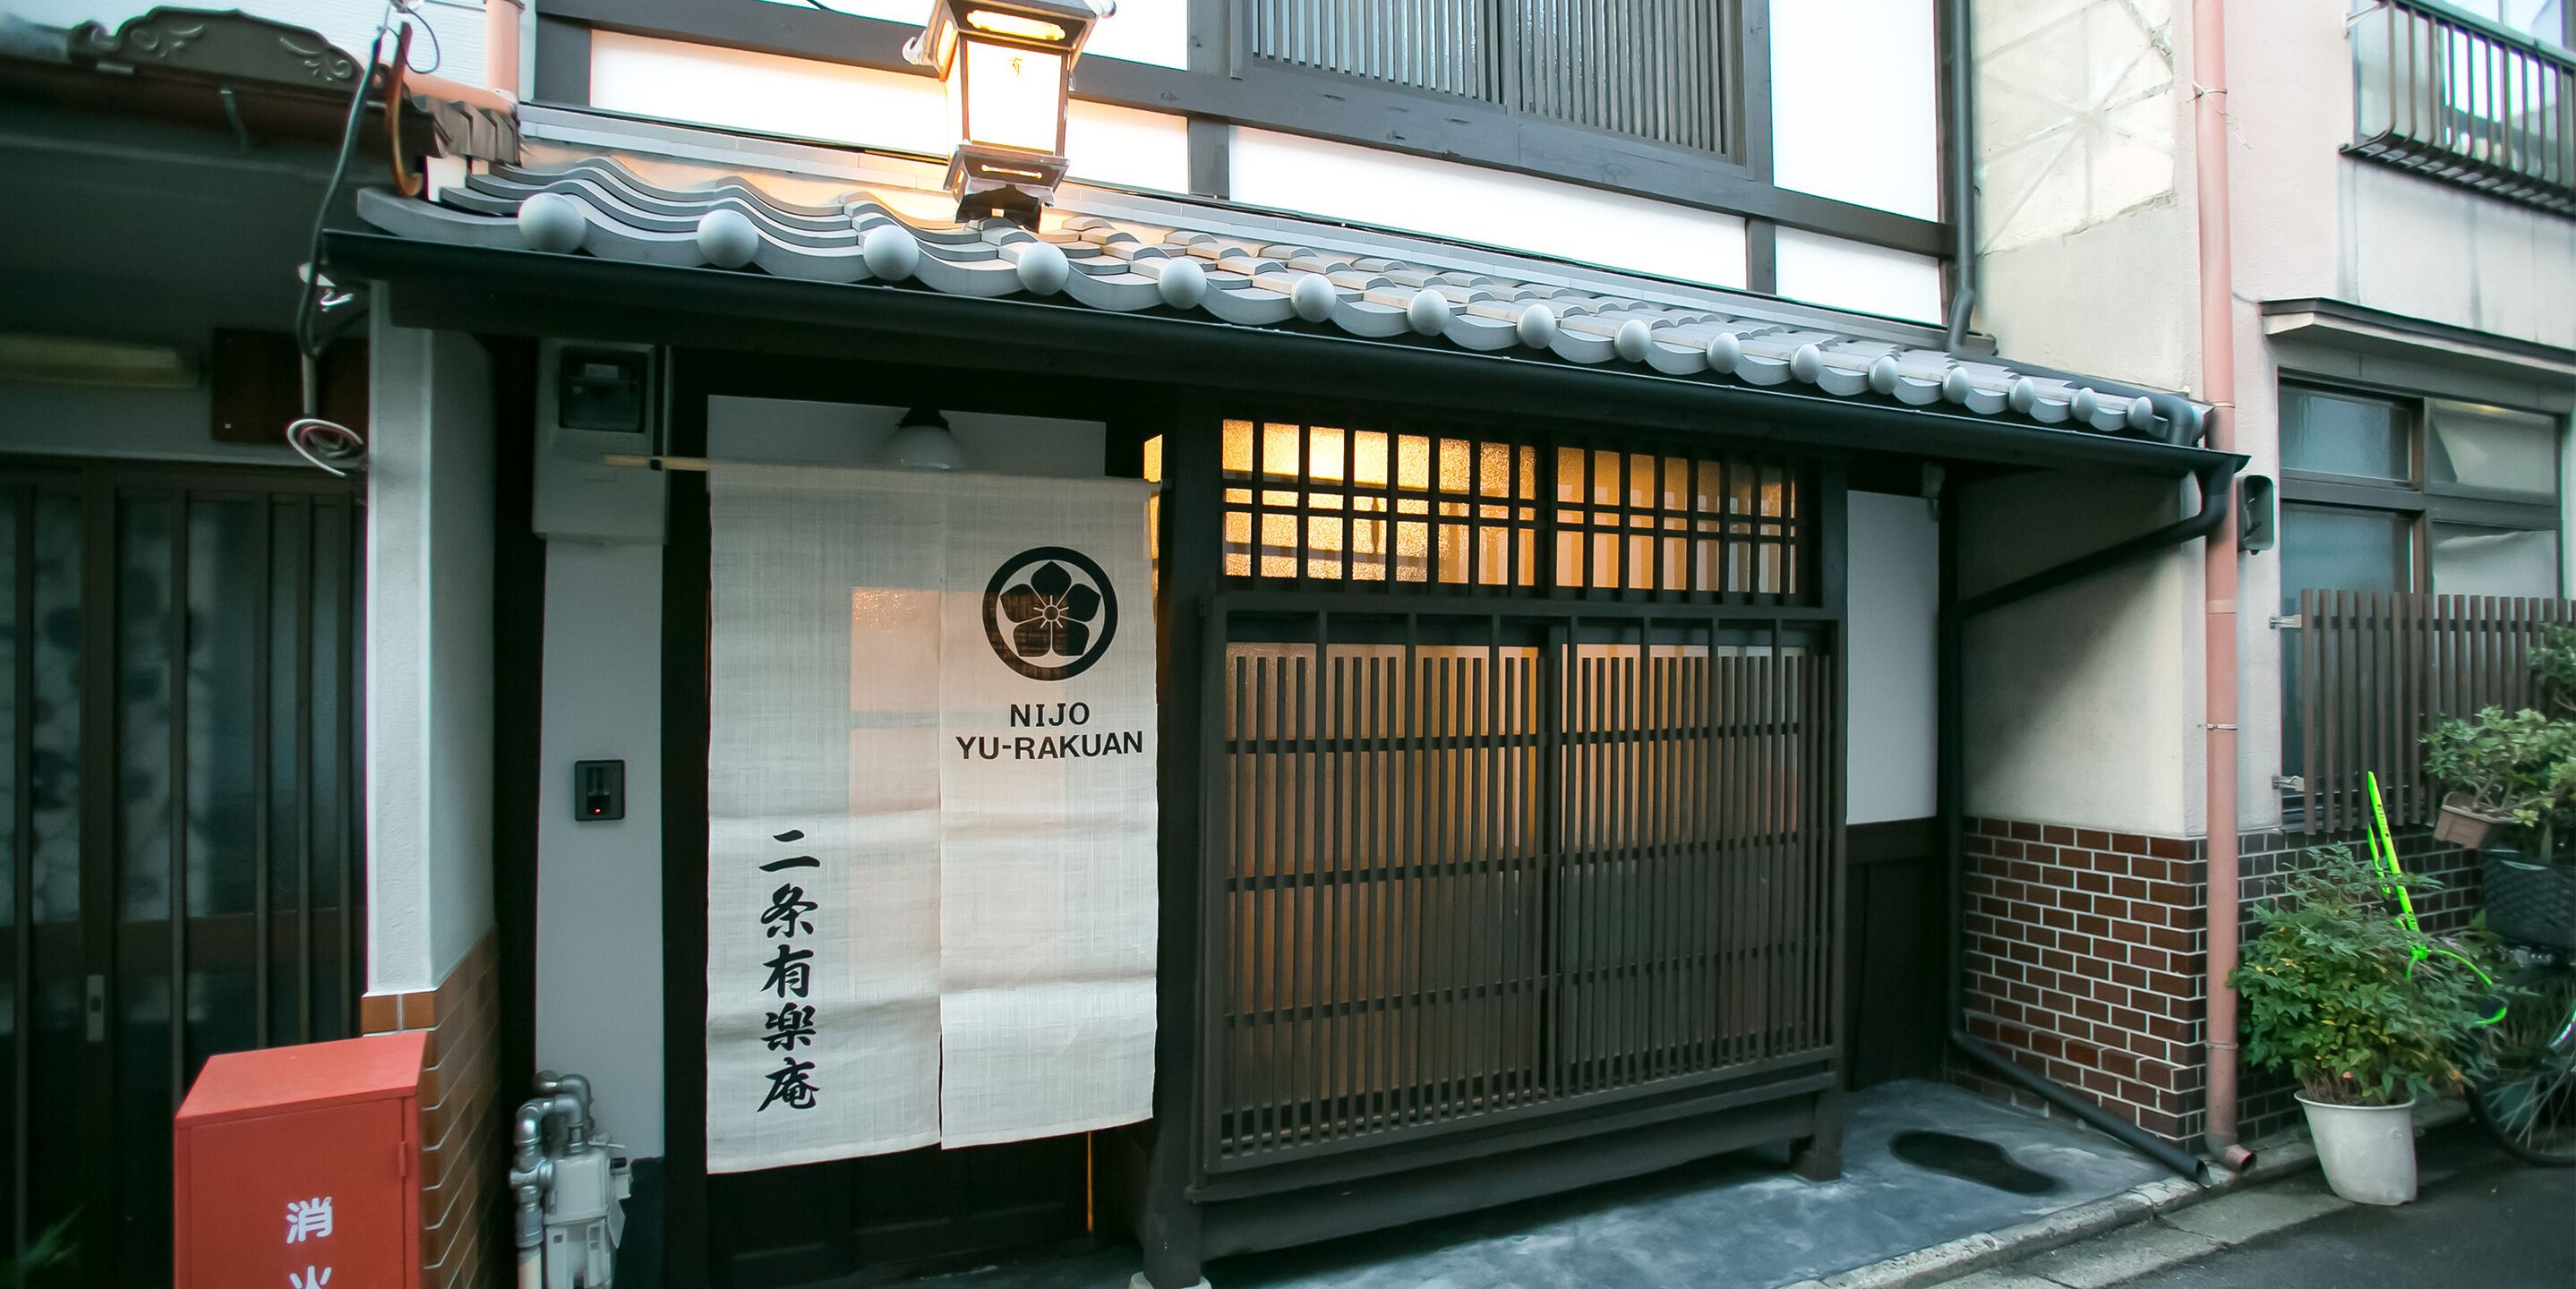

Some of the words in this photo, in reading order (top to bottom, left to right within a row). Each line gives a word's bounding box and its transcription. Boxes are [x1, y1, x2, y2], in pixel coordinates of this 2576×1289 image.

[1010, 702, 1090, 728] NIJO
[955, 730, 1143, 760] YU-RAKUAN
[757, 829, 821, 1113] 二条有楽庵
